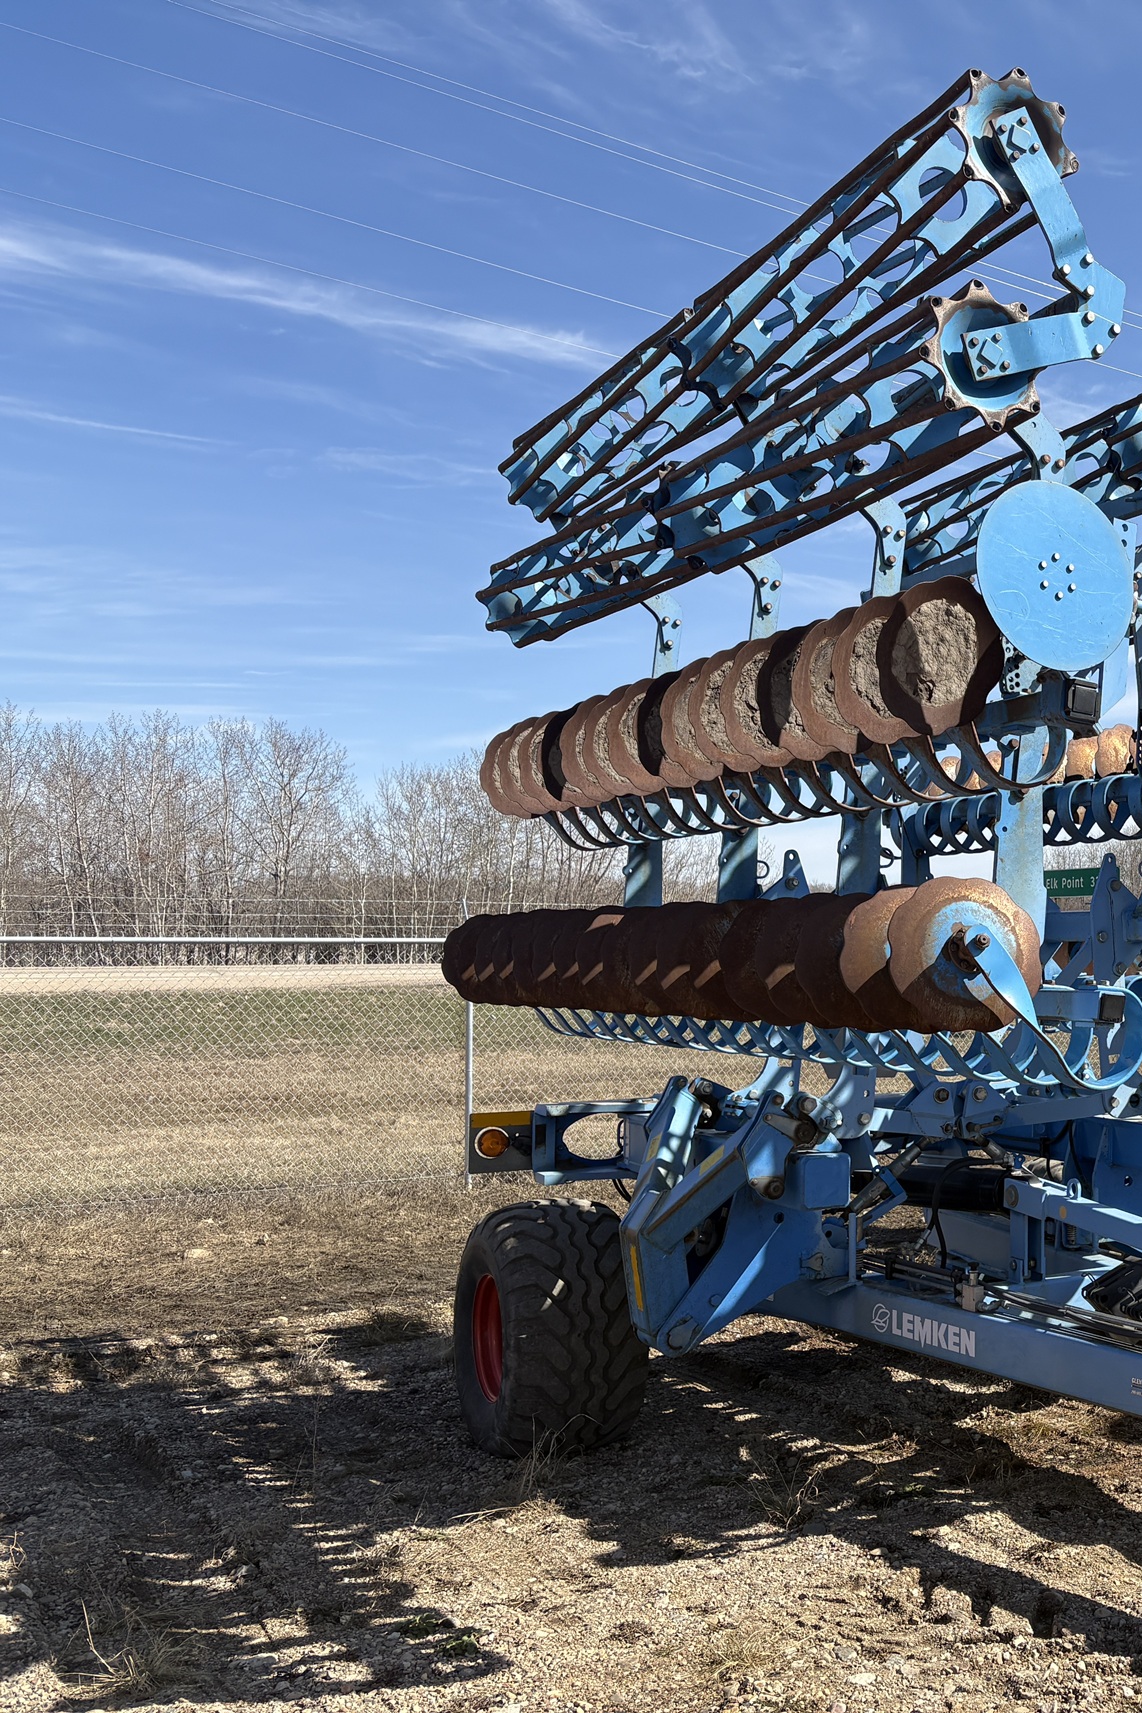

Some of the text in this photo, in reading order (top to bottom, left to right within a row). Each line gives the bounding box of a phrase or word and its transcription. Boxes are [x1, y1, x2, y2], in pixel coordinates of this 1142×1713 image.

[1046, 876, 1098, 889] Elk Point 3
[891, 1309, 976, 1358] LEMKEN
